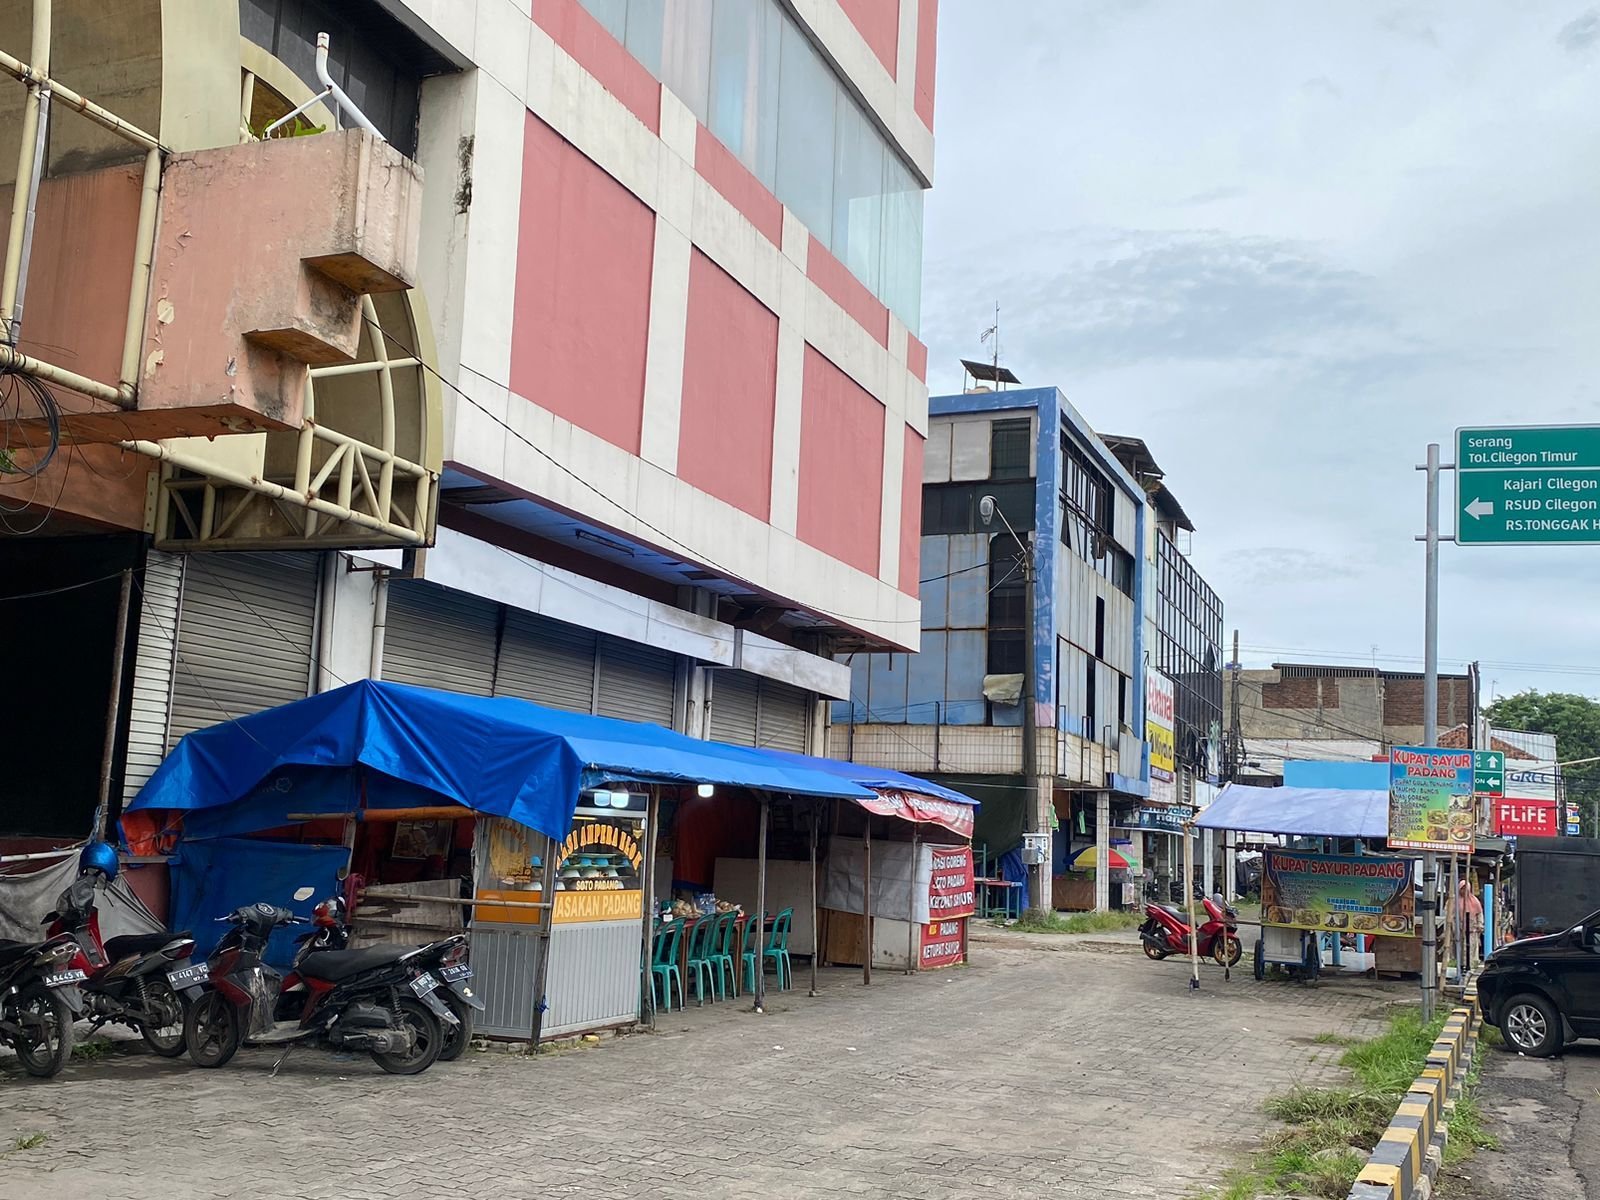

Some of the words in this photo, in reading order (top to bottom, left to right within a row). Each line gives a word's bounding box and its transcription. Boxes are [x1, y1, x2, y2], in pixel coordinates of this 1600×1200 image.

[1468, 437, 1512, 449] Serang
[1540, 451, 1578, 462] Timur
[1504, 478, 1542, 492] Kajari
[1547, 478, 1597, 491] Cilegon
[1505, 499, 1541, 511] RSUD
[1545, 499, 1597, 512] Cilegon
[1505, 519, 1589, 531] RS.TONGGAK
[1393, 750, 1430, 765] KUPAT
[1431, 753, 1471, 768] SAYUR
[1407, 766, 1456, 778] PADANG
[1272, 855, 1308, 872] KUPAT
[1311, 860, 1350, 875] SAYUR
[1353, 862, 1405, 879] PADANG
[576, 880, 593, 890] SOTO
[602, 893, 640, 915] PADANG
